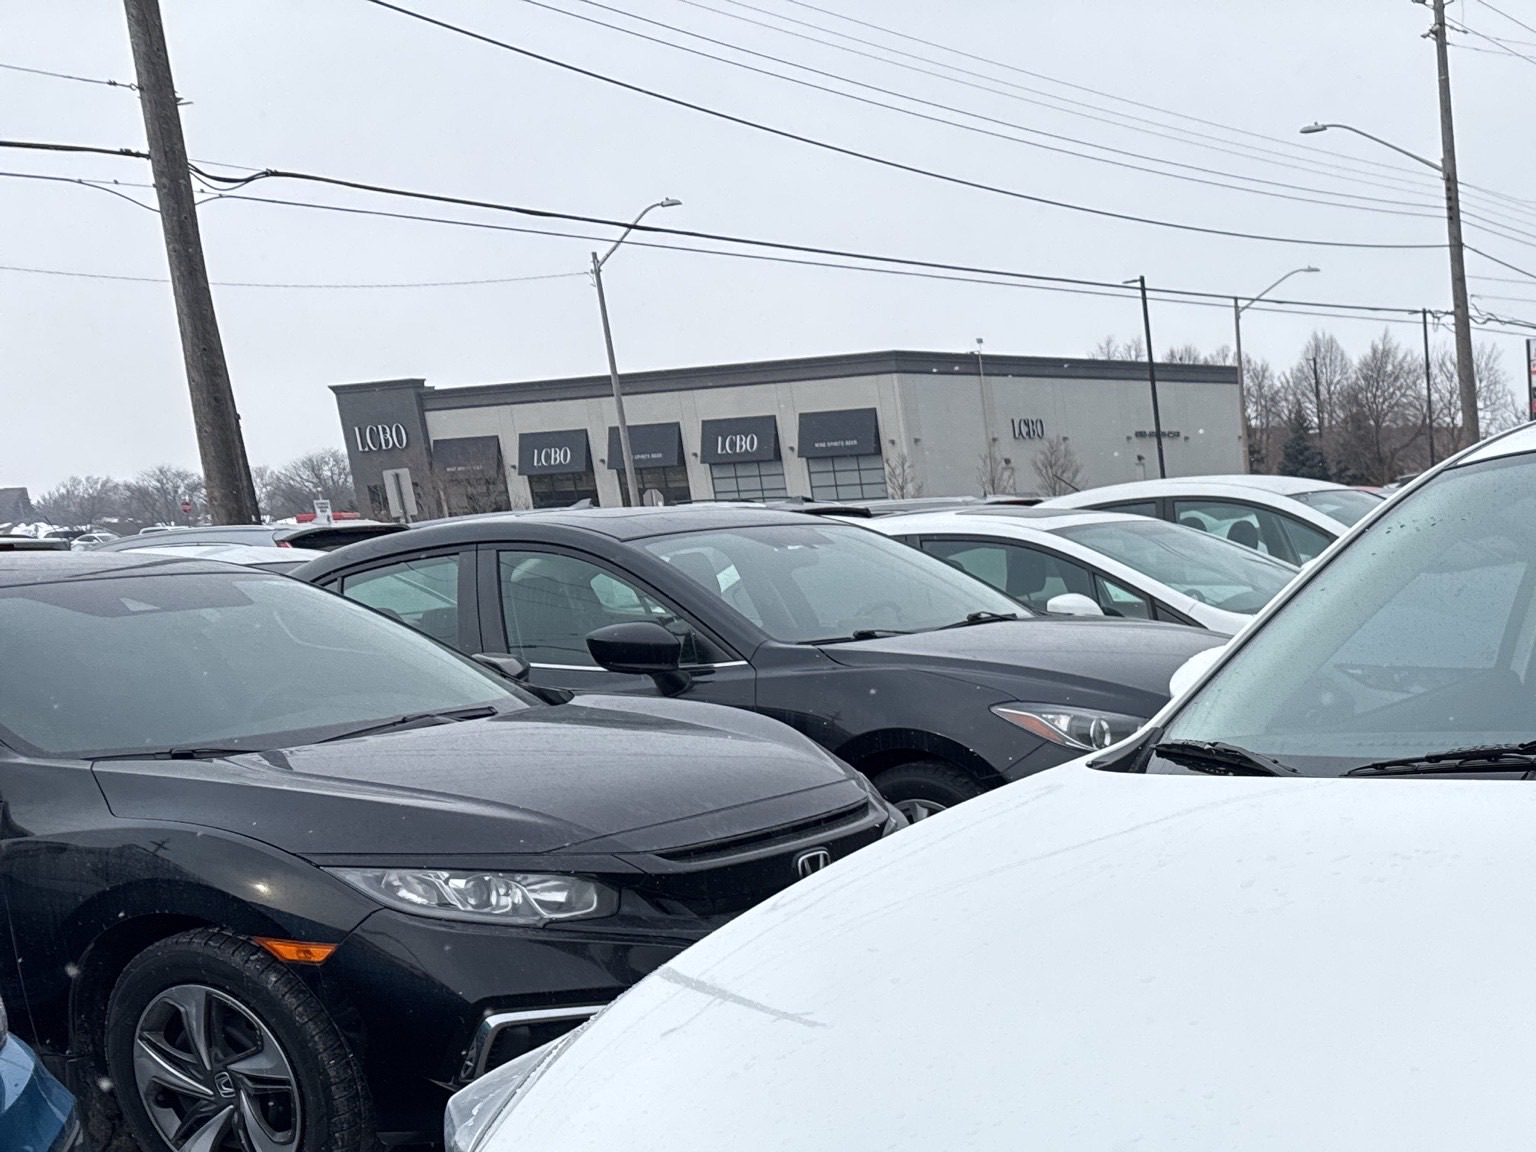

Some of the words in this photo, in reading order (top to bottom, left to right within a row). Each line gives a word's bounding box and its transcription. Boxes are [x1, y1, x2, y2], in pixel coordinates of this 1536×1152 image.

[353, 422, 408, 452] LCBO
[1011, 418, 1045, 440] LCBO
[717, 433, 758, 455] LCBO
[533, 446, 571, 467] LCBO
